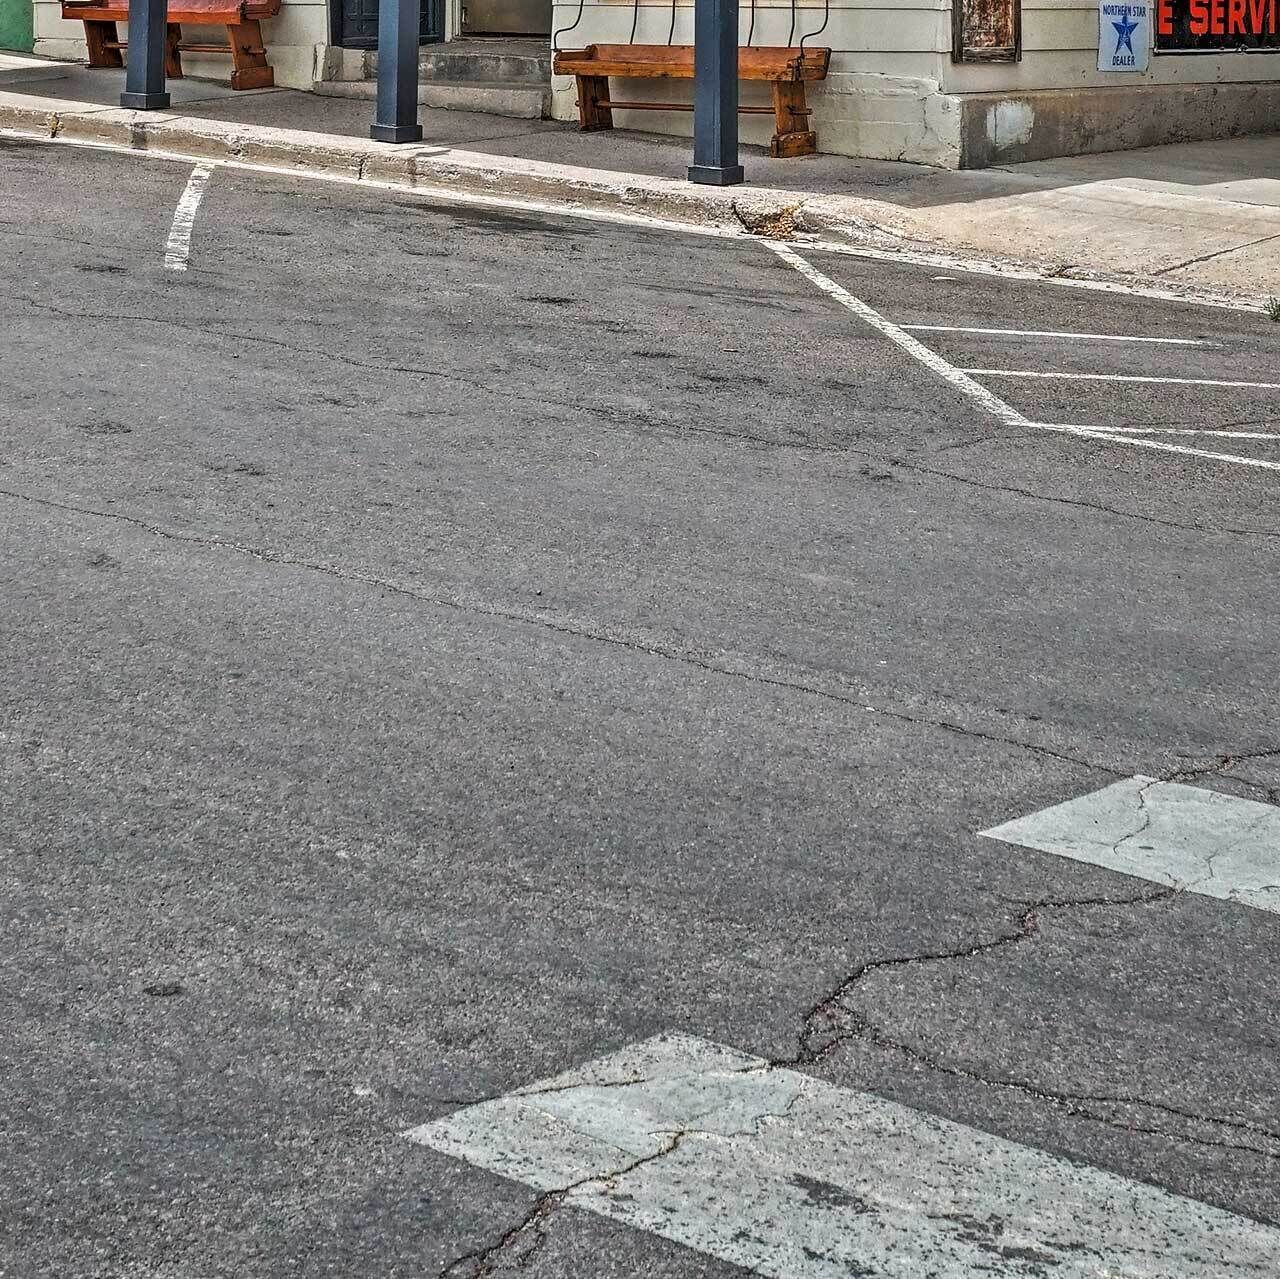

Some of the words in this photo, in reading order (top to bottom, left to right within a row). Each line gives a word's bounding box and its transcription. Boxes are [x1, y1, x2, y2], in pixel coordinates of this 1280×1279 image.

[1102, 4, 1132, 16] NORTHERN
[1132, 6, 1147, 17] STAR
[1112, 54, 1136, 67] DEALER
